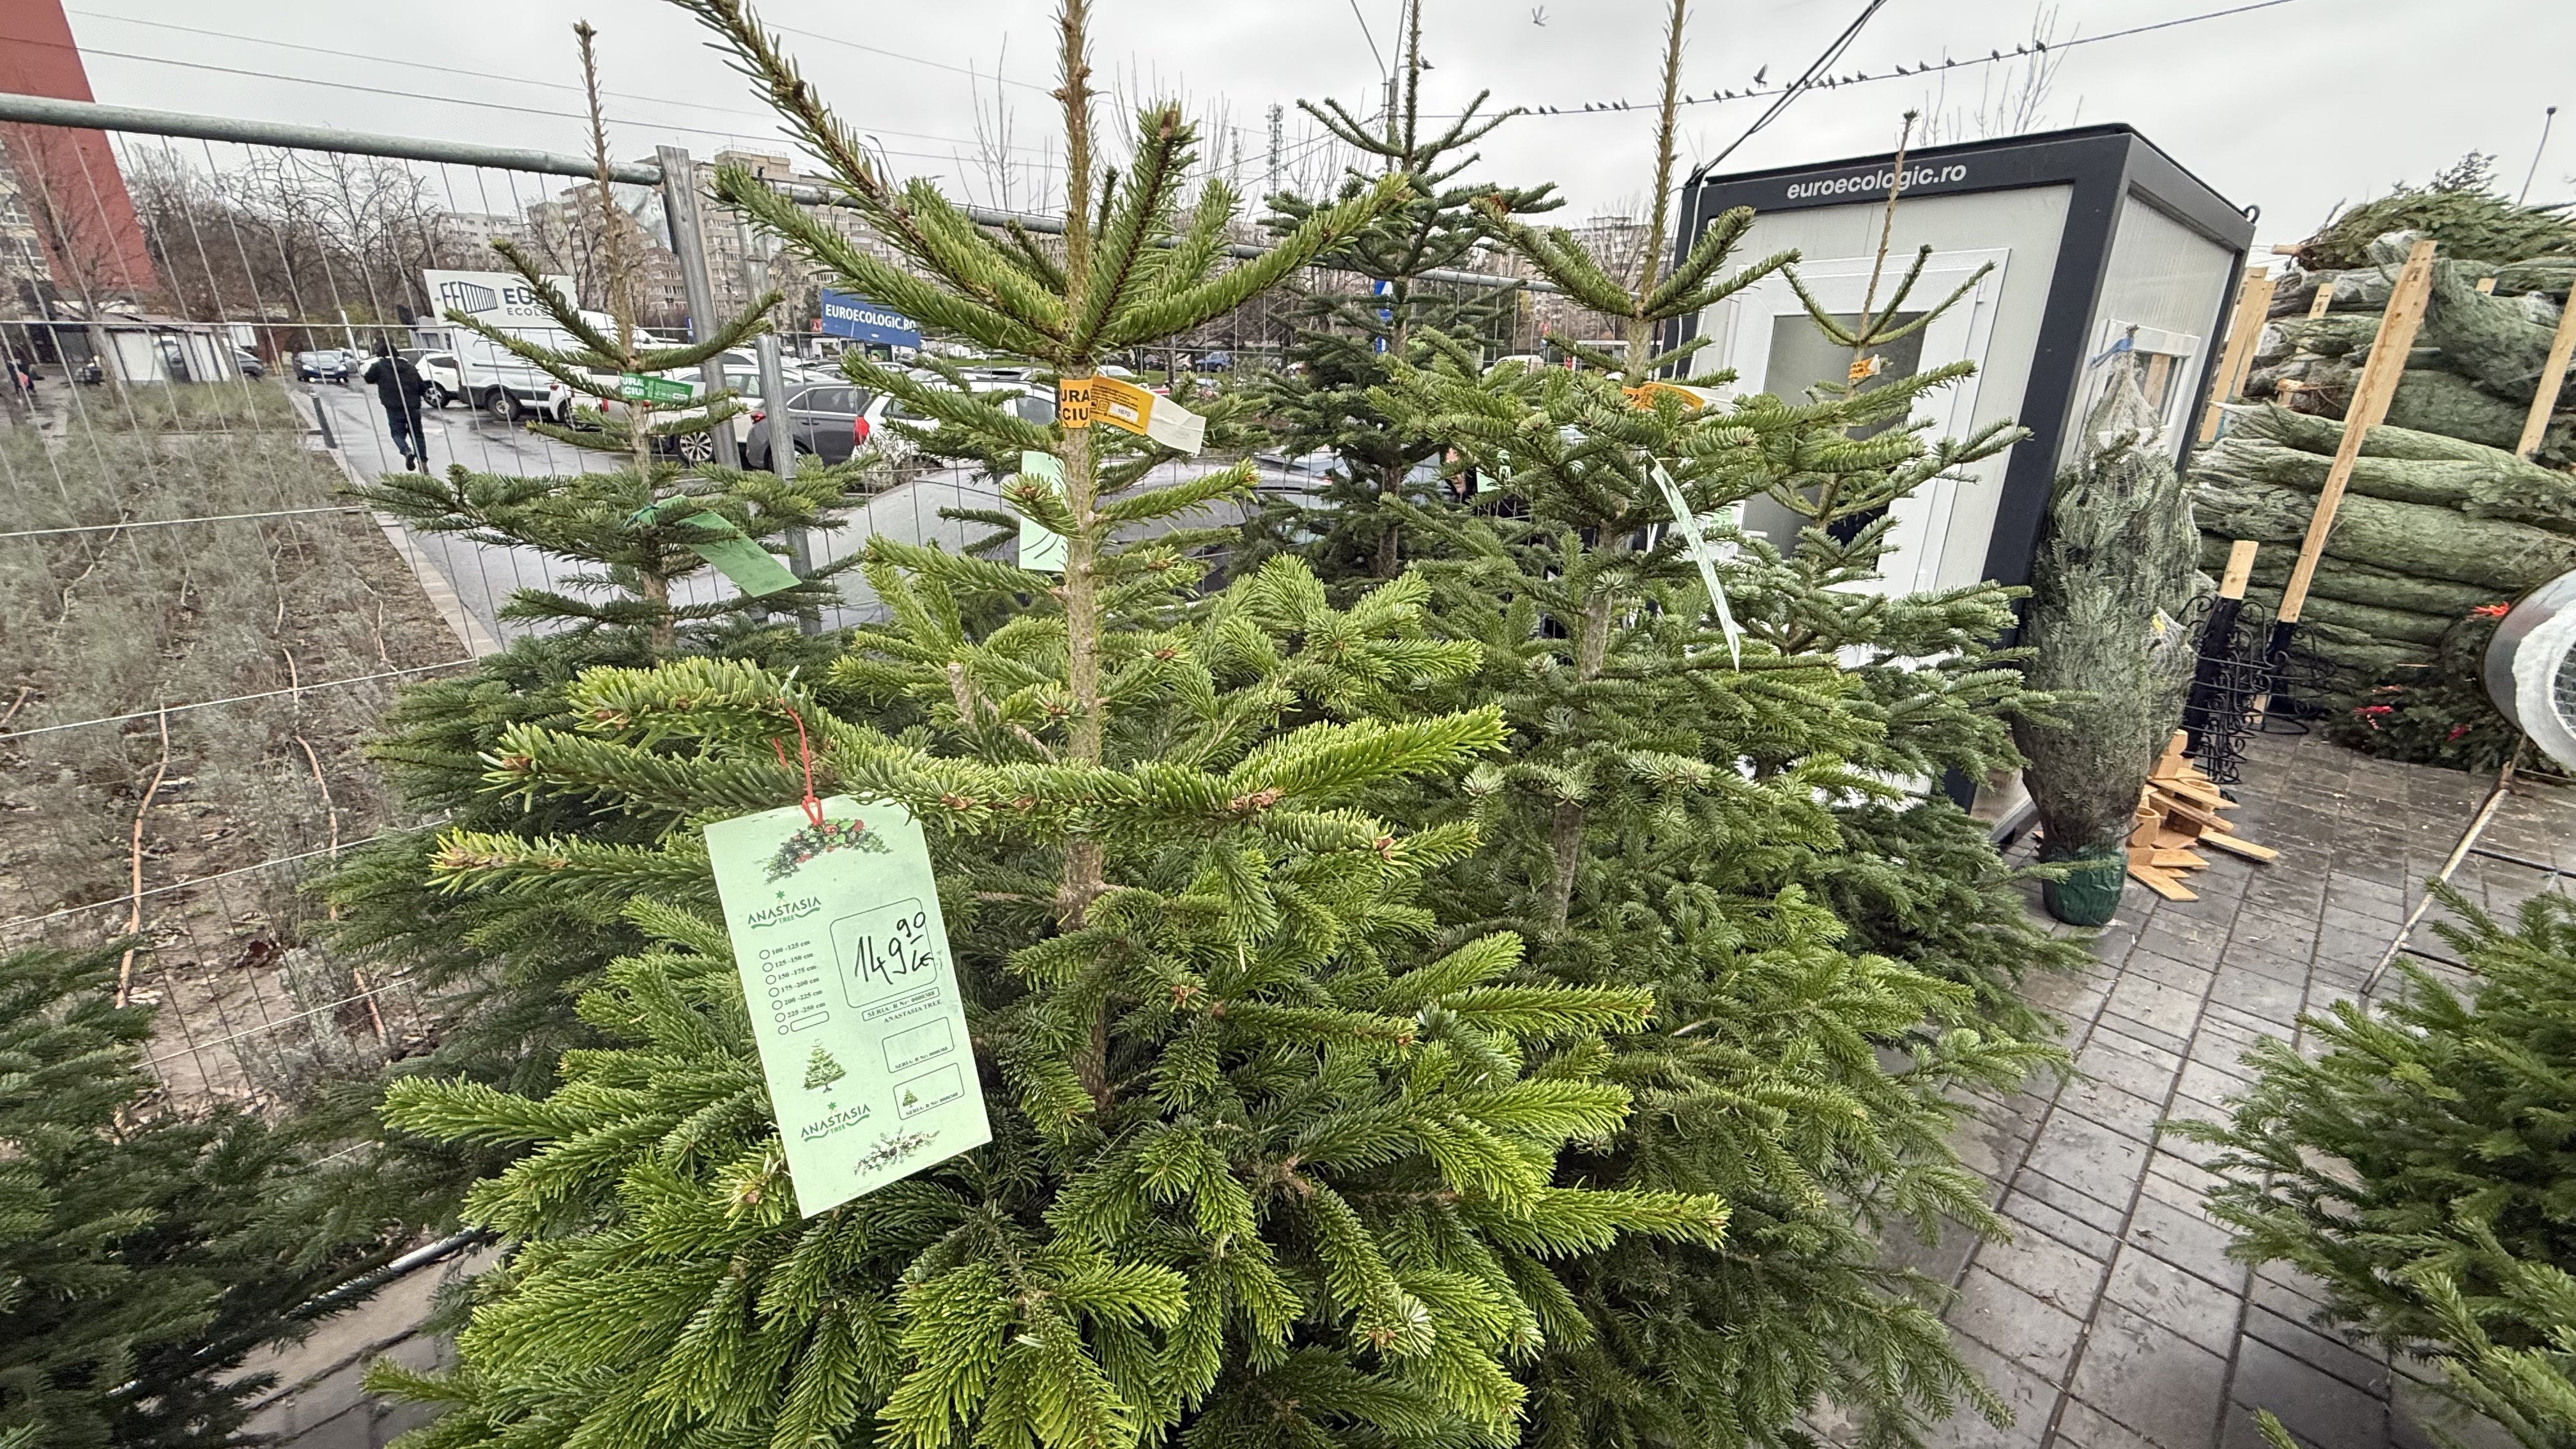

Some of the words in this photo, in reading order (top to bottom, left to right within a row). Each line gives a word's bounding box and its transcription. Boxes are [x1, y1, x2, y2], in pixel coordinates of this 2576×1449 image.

[1787, 164, 1966, 199] euroecologic.ro
[825, 303, 916, 332] EUROECOLOGIC.RO
[747, 896, 822, 924] ANASTASIA
[778, 914, 795, 924] TREE
[884, 1006, 923, 1023] ANASTASIA
[923, 999, 942, 1010] TREE
[801, 1104, 871, 1138] ANASTASIA
[830, 1124, 846, 1134] TREE
